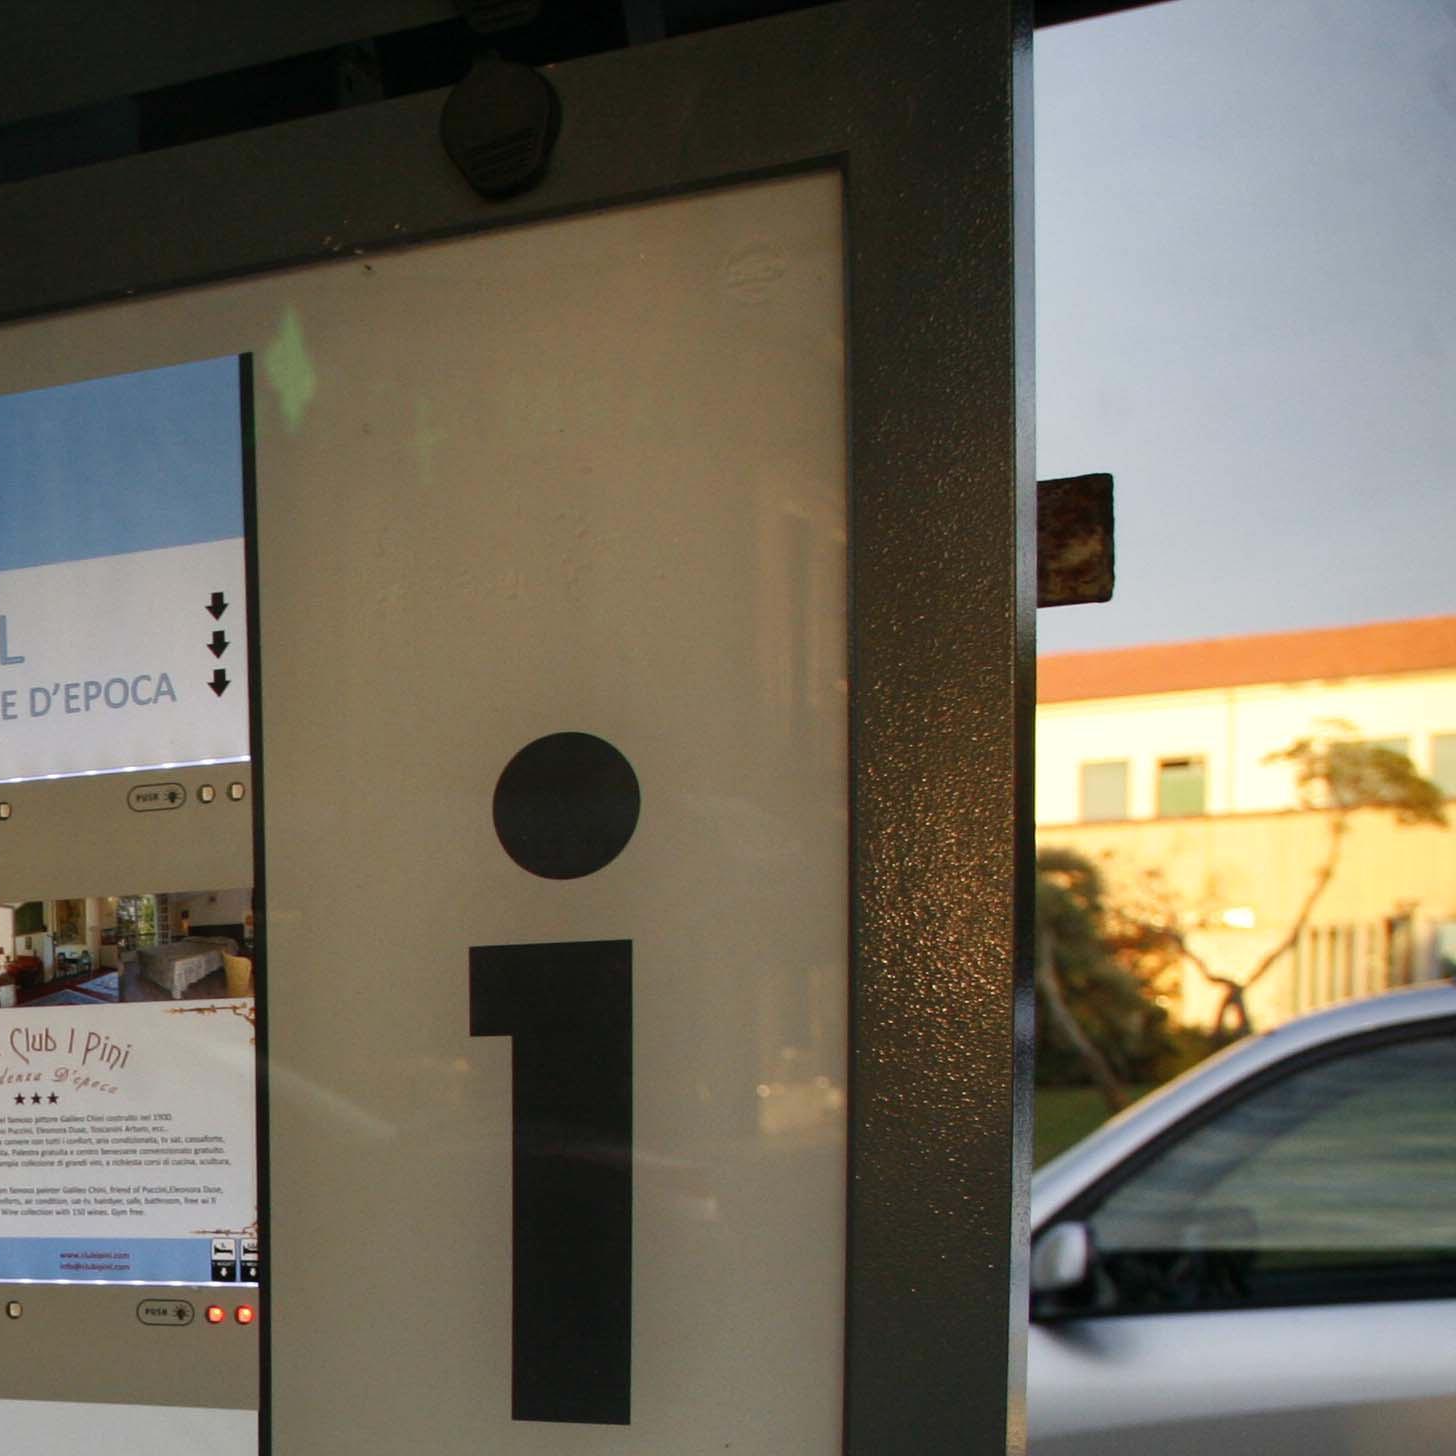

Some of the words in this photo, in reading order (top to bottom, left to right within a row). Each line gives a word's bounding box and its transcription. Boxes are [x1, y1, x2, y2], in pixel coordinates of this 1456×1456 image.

[30, 672, 177, 719] D'EPOCA
[9, 1027, 57, 1065] Club
[67, 1027, 75, 1054] I
[81, 1031, 133, 1070] Pini
